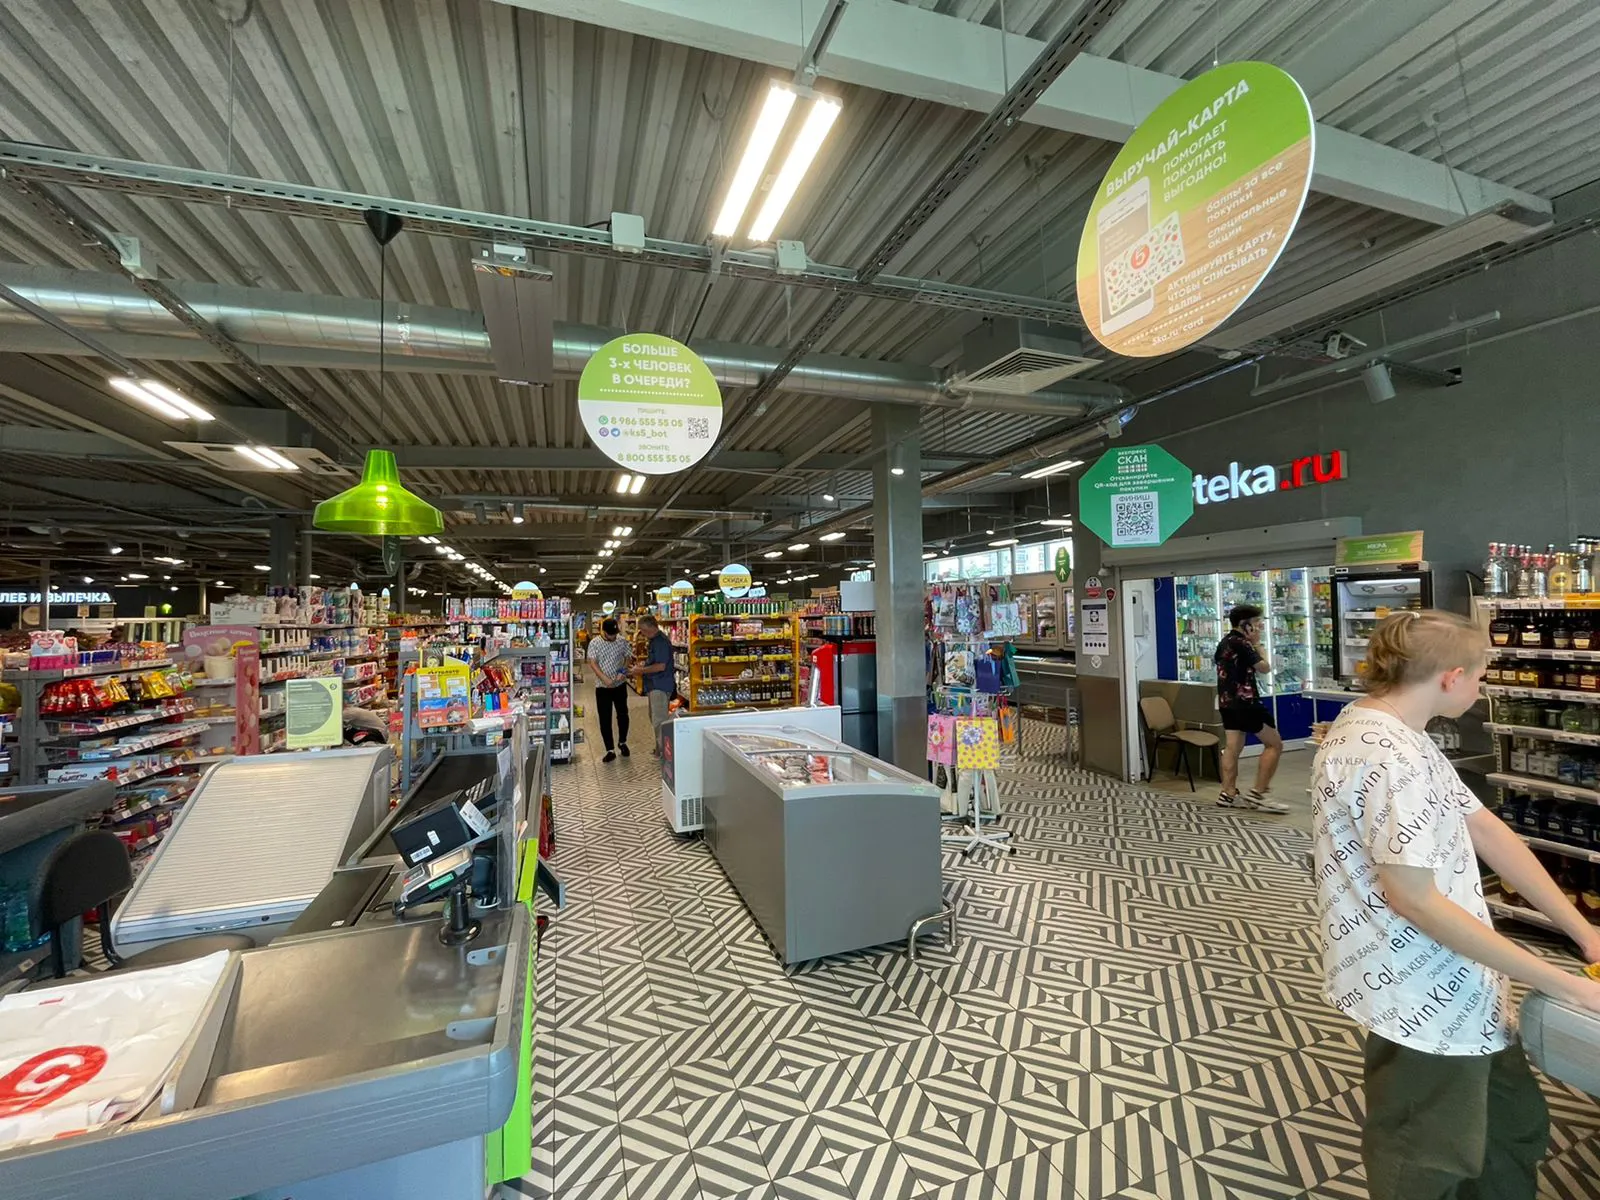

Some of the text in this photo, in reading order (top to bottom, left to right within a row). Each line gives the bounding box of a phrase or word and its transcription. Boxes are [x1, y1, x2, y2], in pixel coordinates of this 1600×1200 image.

[1106, 79, 1250, 197] ВЫРУЧАЙ-КАРТА
[1162, 120, 1227, 174] ПОМОГАЕТ
[1162, 140, 1227, 188] ПОКУПАТЬ
[1163, 152, 1227, 202] ВЫГОДНО!
[1208, 188, 1287, 238] специальные
[1167, 249, 1235, 292] АКТИВИРУЙТЕ
[1202, 248, 1268, 285] СПИСЫВАТЬ
[609, 357, 692, 373] 3-х ЧЕЛОВЕК
[623, 343, 678, 357] БОЛЬШЕ
[612, 374, 690, 389] В ОЧЕРЕДИ?
[611, 416, 617, 424] 8
[671, 419, 683, 427] 05
[617, 453, 624, 461] 8
[626, 453, 645, 462] 800
[647, 454, 664, 462] 555
[679, 455, 691, 463] 05
[1109, 473, 1158, 482] Отсканируйте
[1117, 454, 1147, 465] СКАН
[1192, 450, 1343, 505] teka.ru
[0, 592, 27, 603] ЛЕБ
[30, 592, 41, 603] И
[1387, 808, 1432, 855] Calvin
[1427, 965, 1471, 1008] Klein
